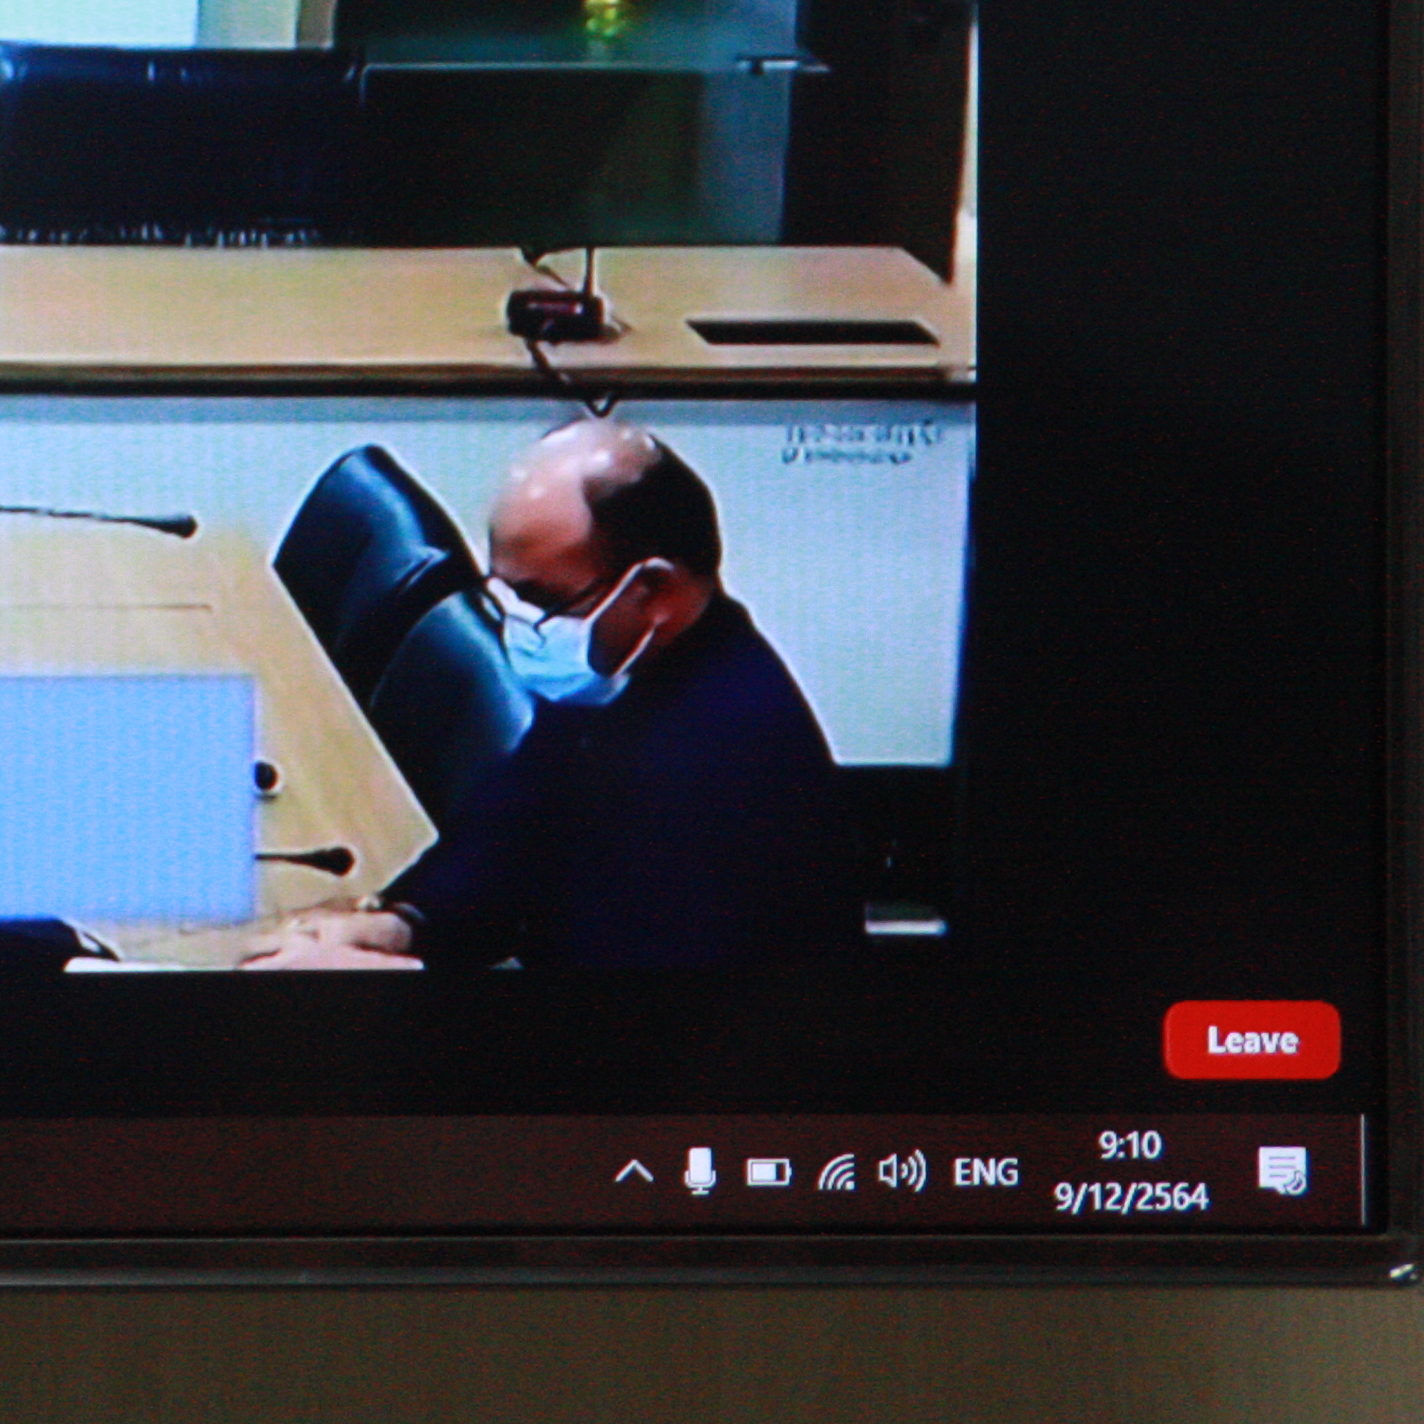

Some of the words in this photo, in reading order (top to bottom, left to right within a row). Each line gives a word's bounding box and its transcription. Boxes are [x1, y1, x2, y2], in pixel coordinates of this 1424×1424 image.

[1207, 1025, 1300, 1054] Leave
[1098, 1130, 1163, 1159] 9:10
[954, 1157, 1019, 1187] ENG
[1054, 1182, 1209, 1214] 9/12/2564
